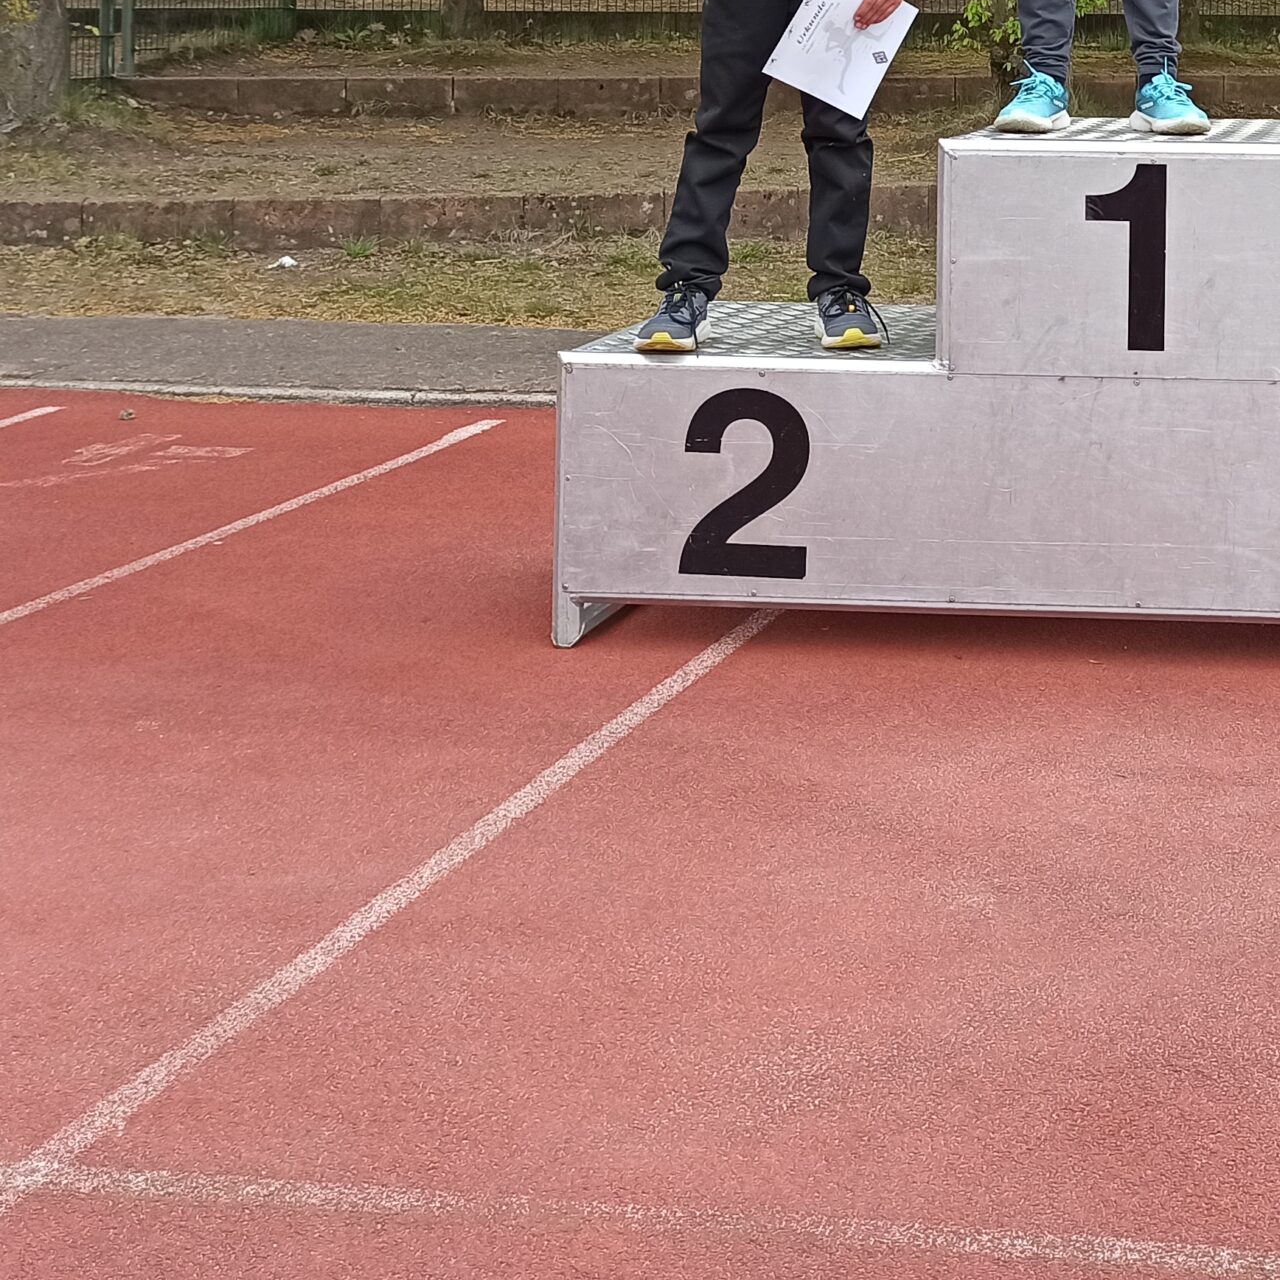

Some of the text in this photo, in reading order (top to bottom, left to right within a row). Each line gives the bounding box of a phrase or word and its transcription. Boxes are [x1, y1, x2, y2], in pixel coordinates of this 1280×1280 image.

[795, 0, 828, 46] Urkunde
[1085, 163, 1168, 352] 1
[677, 387, 811, 580] 2
